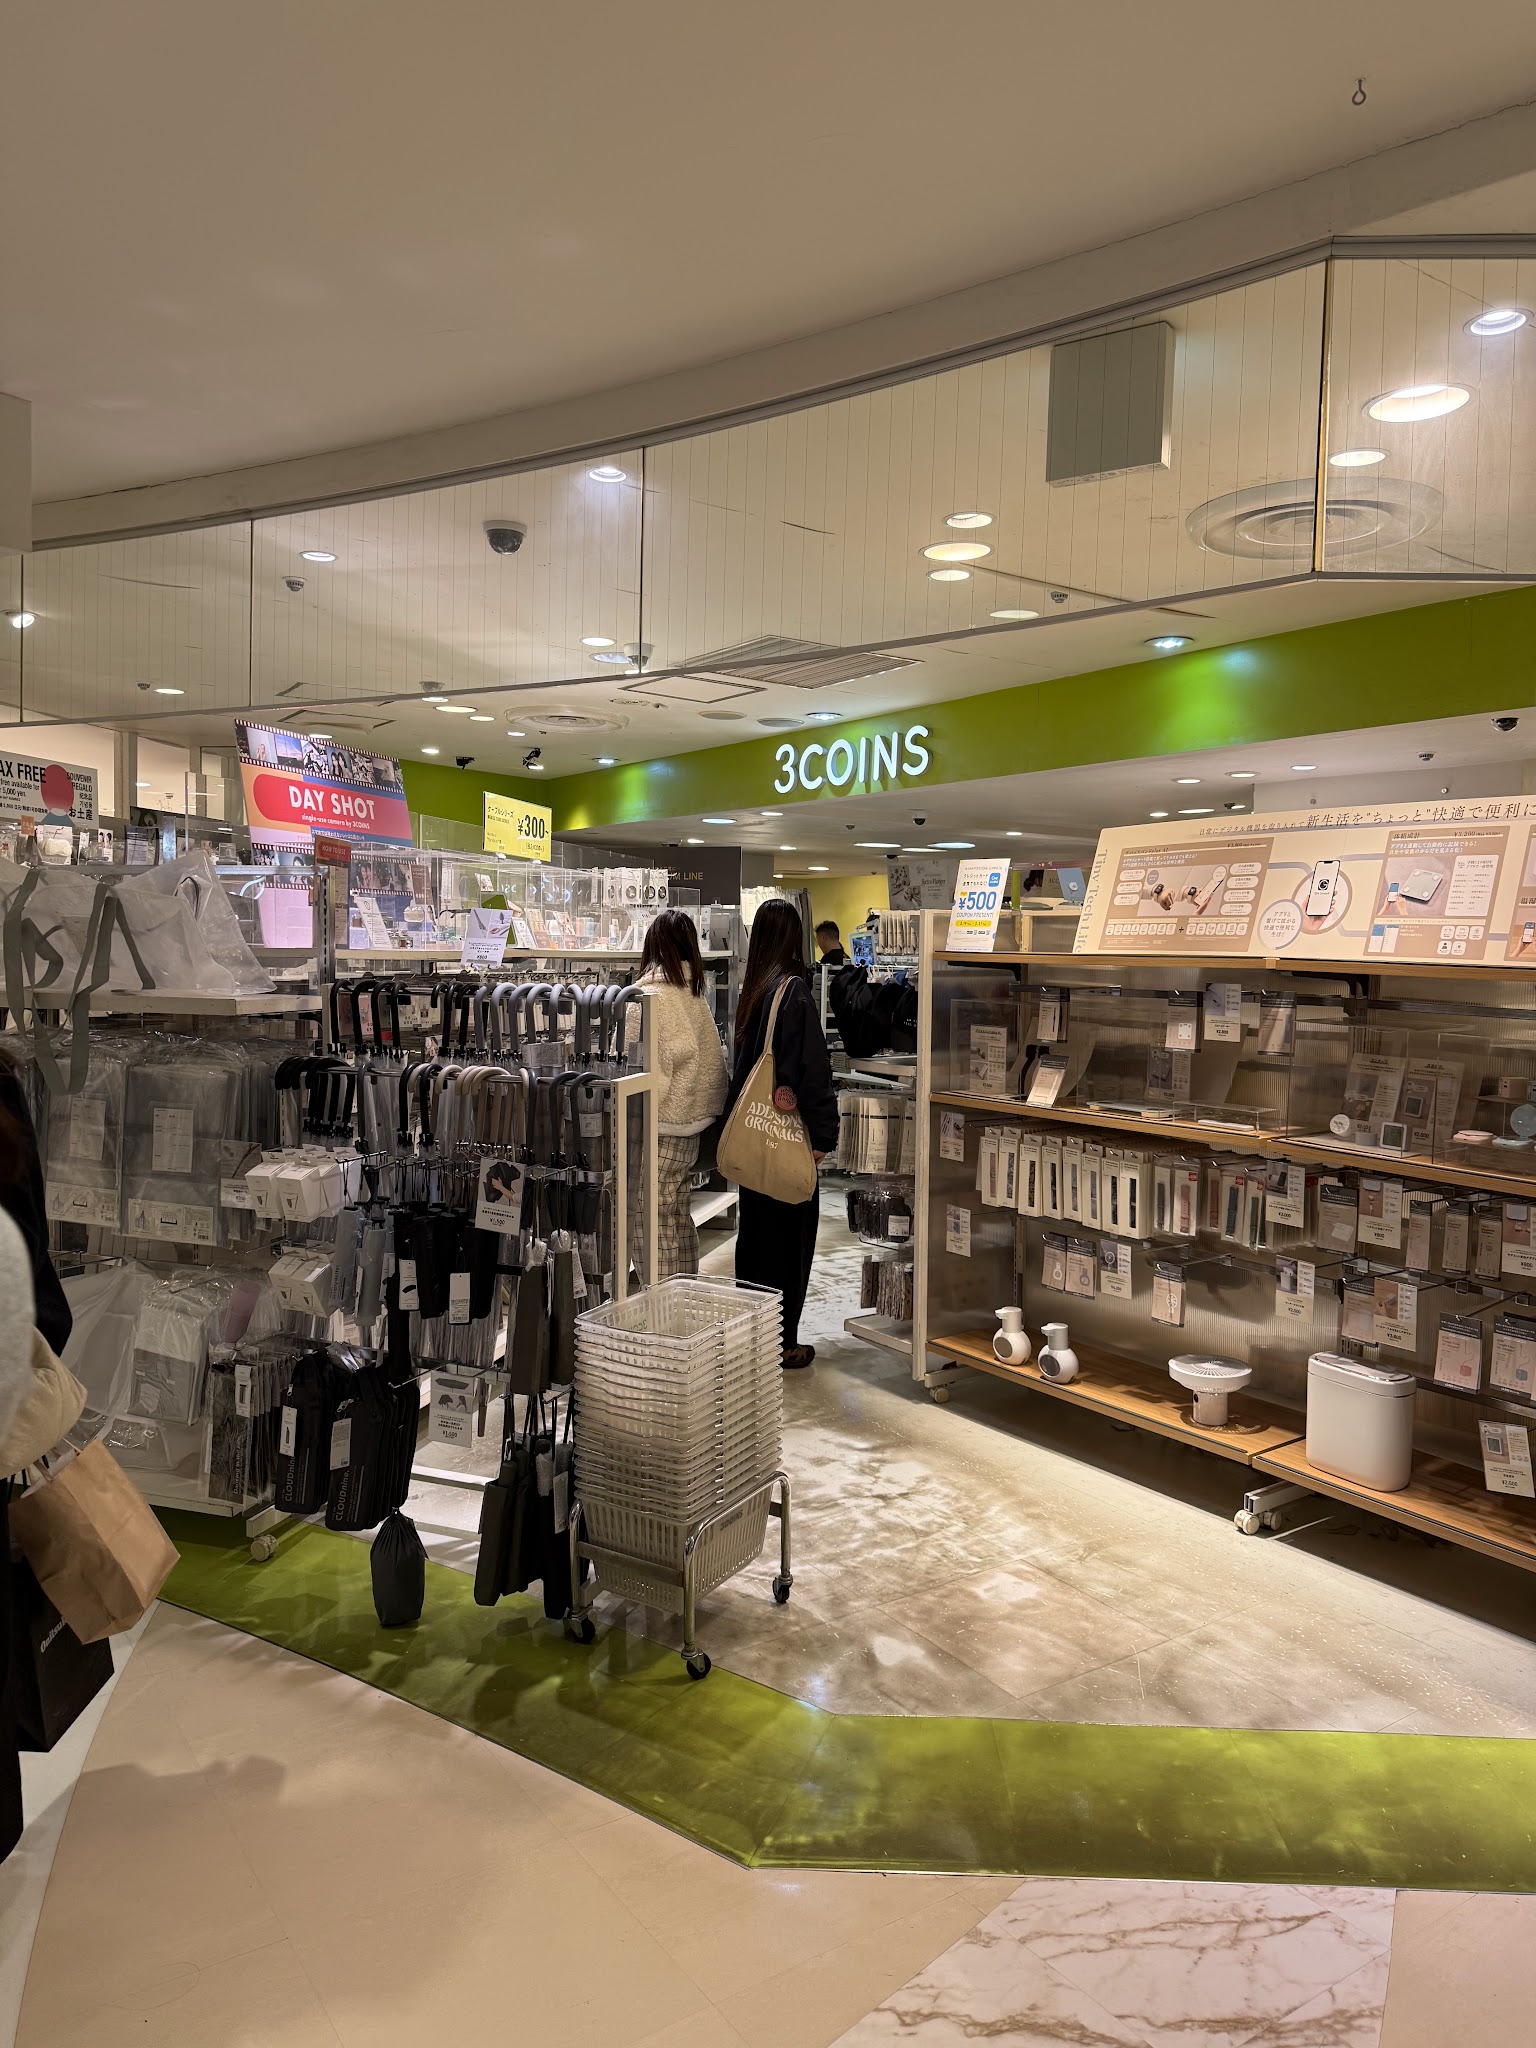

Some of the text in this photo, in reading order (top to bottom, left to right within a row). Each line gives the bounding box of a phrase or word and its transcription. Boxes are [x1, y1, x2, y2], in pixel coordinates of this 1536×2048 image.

[774, 725, 929, 794] 3COINS
[0, 760, 46, 783] AX FREE
[67, 771, 92, 783] SOUVENIR
[2, 787, 16, 796] 5,000
[11, 780, 32, 790] available
[72, 782, 92, 792] REGALO
[288, 786, 375, 820] DAY SHOT
[68, 806, 92, 820] お土産
[488, 806, 514, 818] ケーブルシリーズ
[302, 812, 370, 830] single-use camera by 3COINS
[322, 844, 332, 853] HOW
[684, 872, 704, 880] LINE
[958, 891, 997, 910] ¥500
[1074, 850, 1107, 953] Tiny Tech Life
[766, 1138, 778, 1150] 187
[40, 1616, 66, 1653] Onitsu
